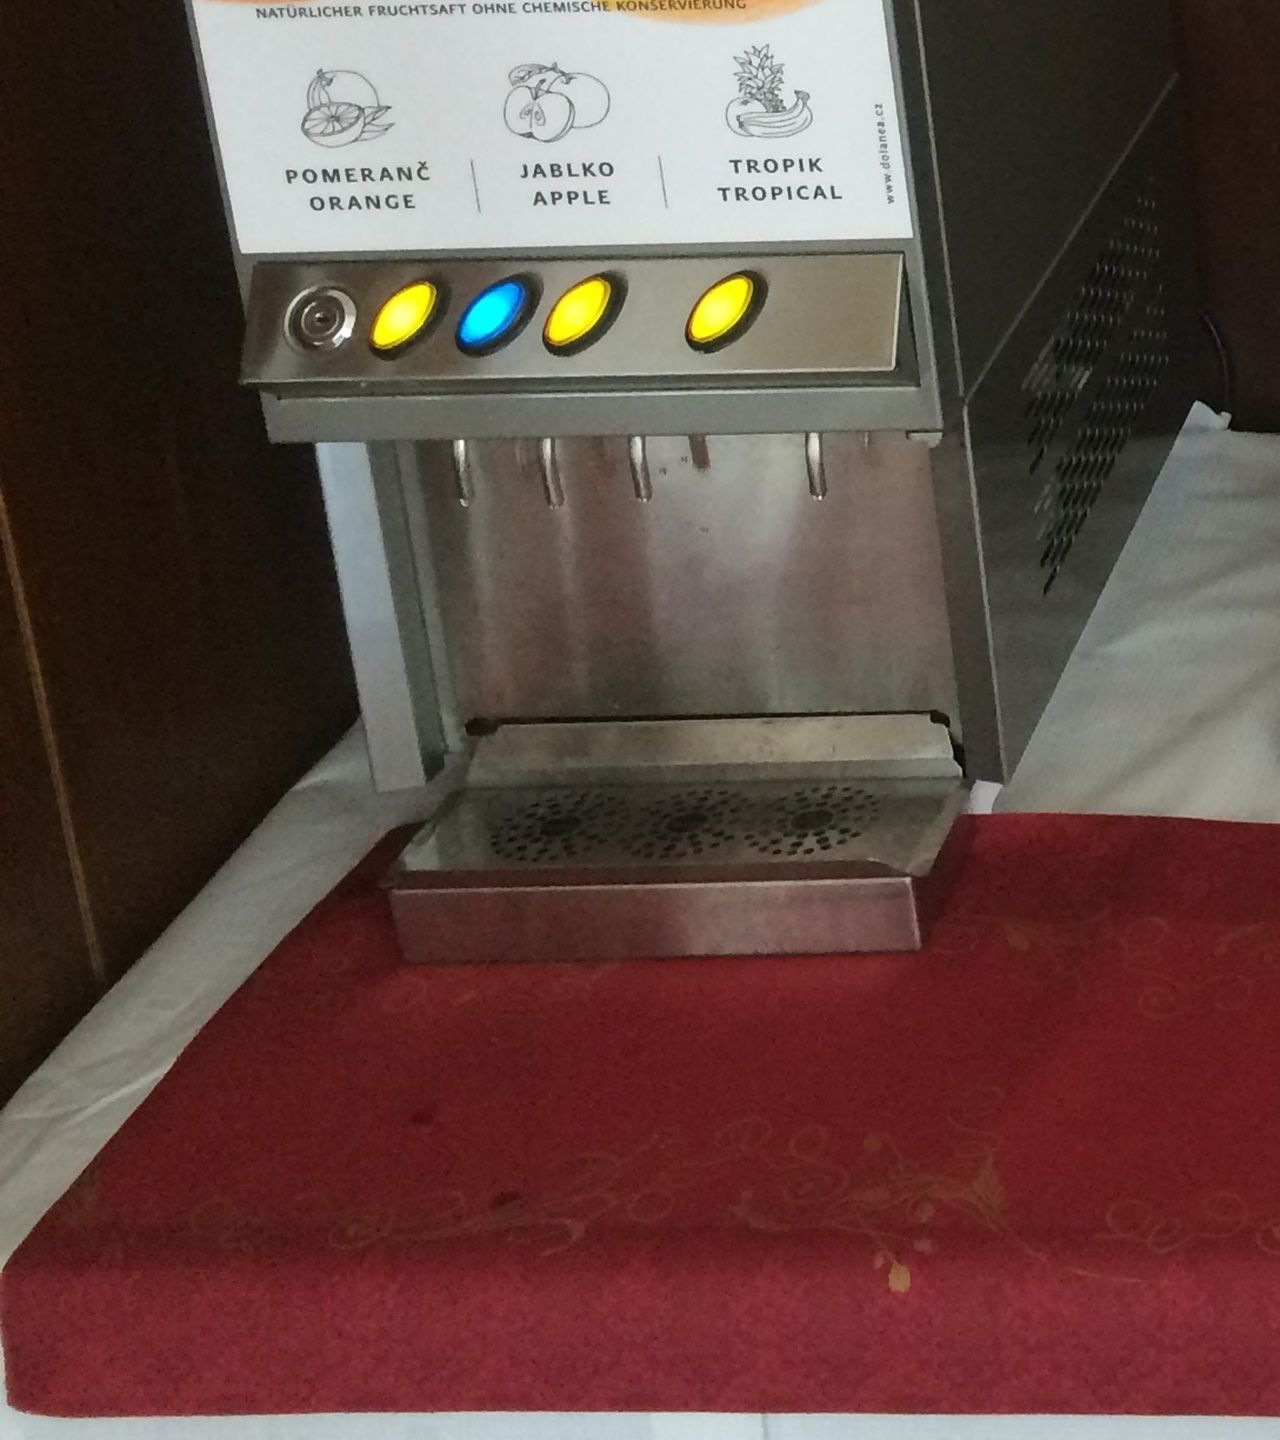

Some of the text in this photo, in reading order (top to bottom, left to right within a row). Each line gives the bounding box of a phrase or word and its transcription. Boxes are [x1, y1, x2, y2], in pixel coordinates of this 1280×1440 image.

[256, 4, 363, 19] NATÜRLICHER
[368, 3, 467, 17] FRUCHTSAFT
[472, 2, 517, 15] OHNE
[522, 0, 611, 14] CHEMISCHE
[874, 102, 895, 205] www.dolanea.cz
[285, 161, 431, 184] POMERANČ
[520, 161, 615, 179] JABLKO
[729, 158, 823, 174] TROPIK
[532, 190, 612, 207] APPLE
[717, 185, 842, 202] TROPICAL
[309, 194, 416, 211] ORANGE
